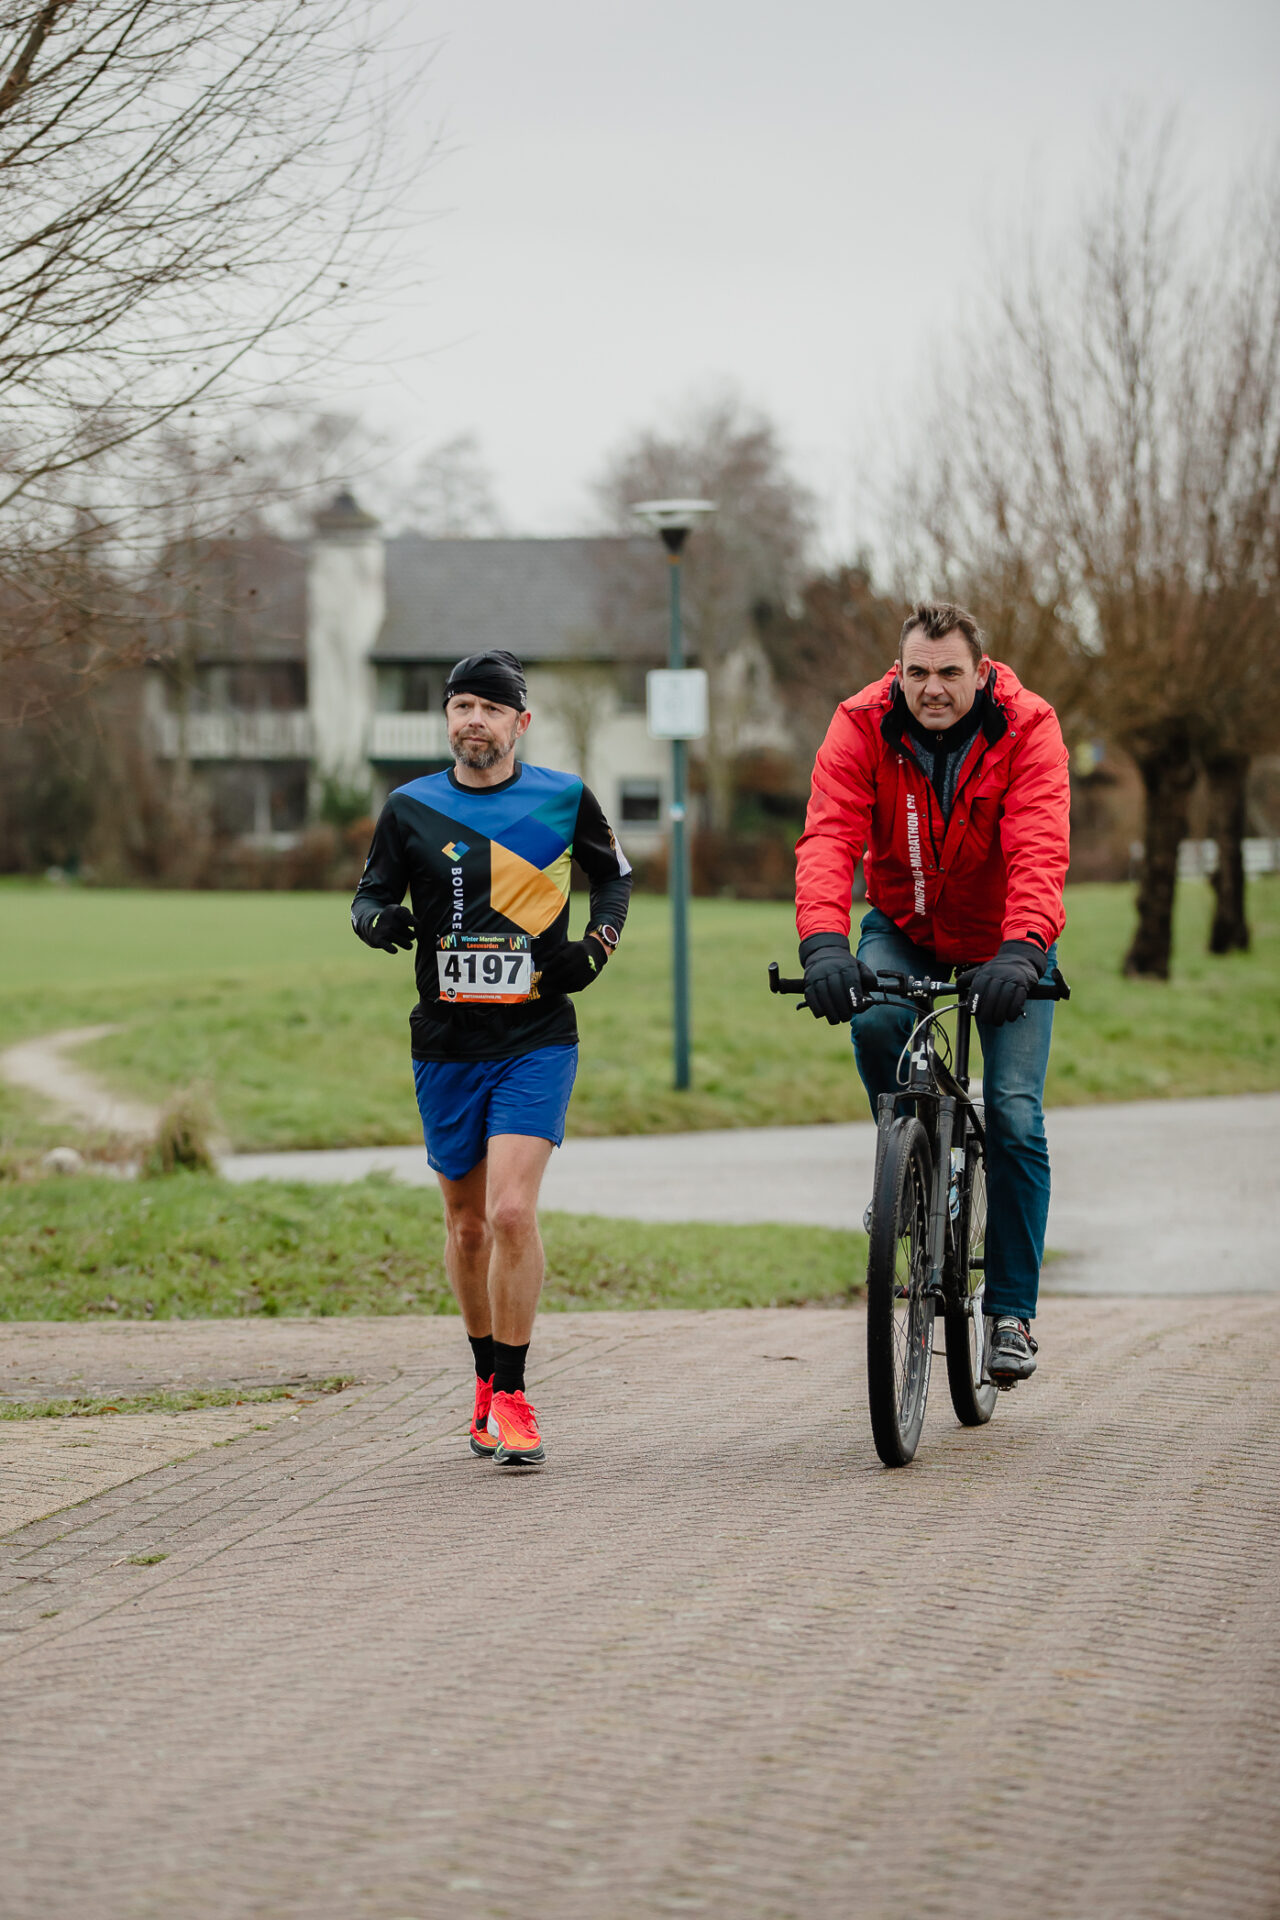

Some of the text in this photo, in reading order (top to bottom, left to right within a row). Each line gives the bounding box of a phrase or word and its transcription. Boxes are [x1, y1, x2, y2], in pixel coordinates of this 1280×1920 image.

[451, 867, 463, 933] BOUWCE
[461, 935, 505, 943] Winter Marathon
[444, 954, 524, 985] 4197
